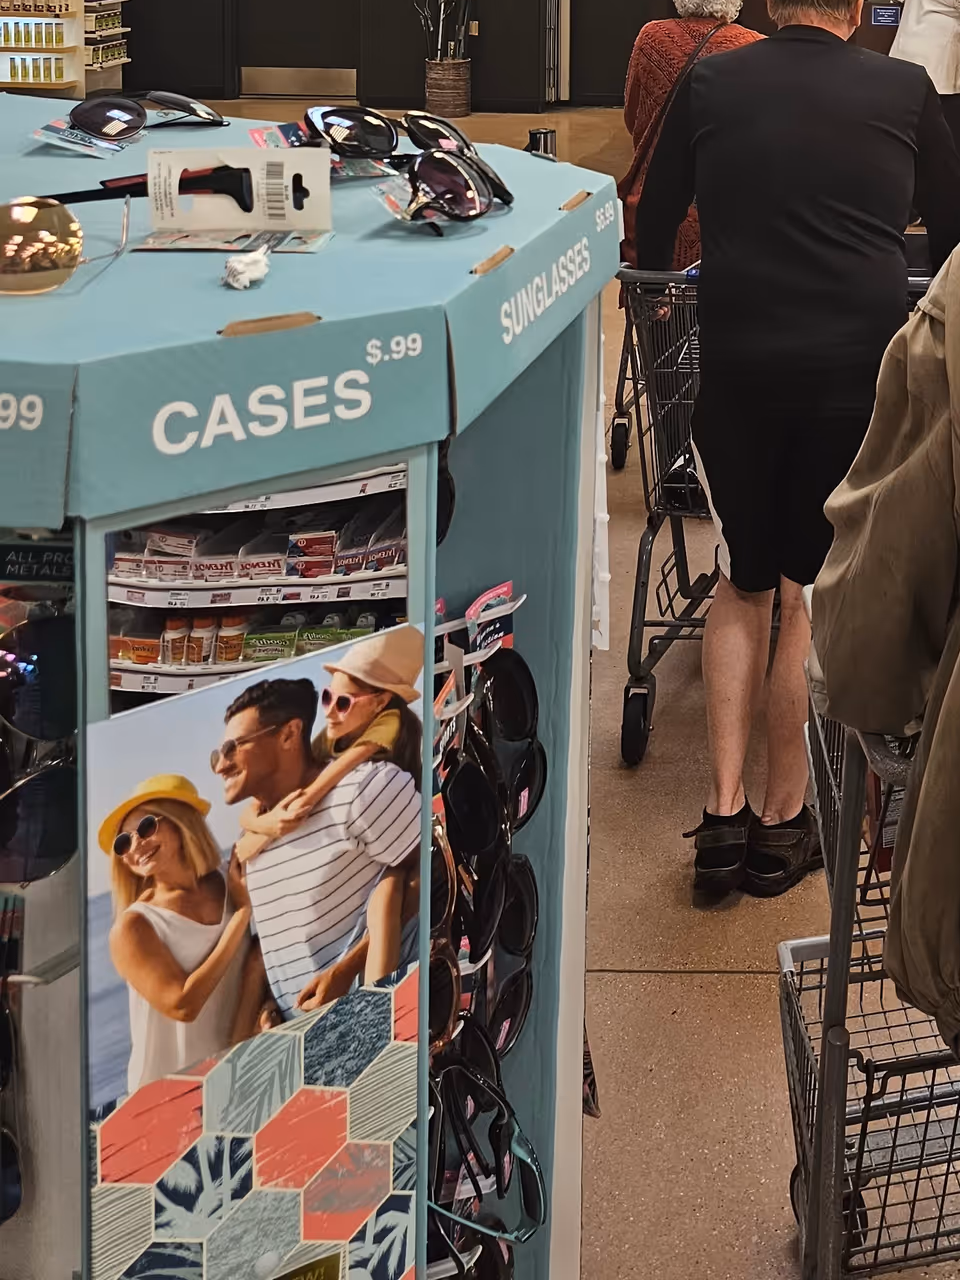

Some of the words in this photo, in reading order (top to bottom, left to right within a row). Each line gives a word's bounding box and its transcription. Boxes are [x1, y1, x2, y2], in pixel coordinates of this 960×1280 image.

[500, 237, 591, 344] SUNGLASSES
[365, 333, 422, 366] $.99
[152, 369, 372, 455] CASES
[6, 564, 73, 576] METALS
